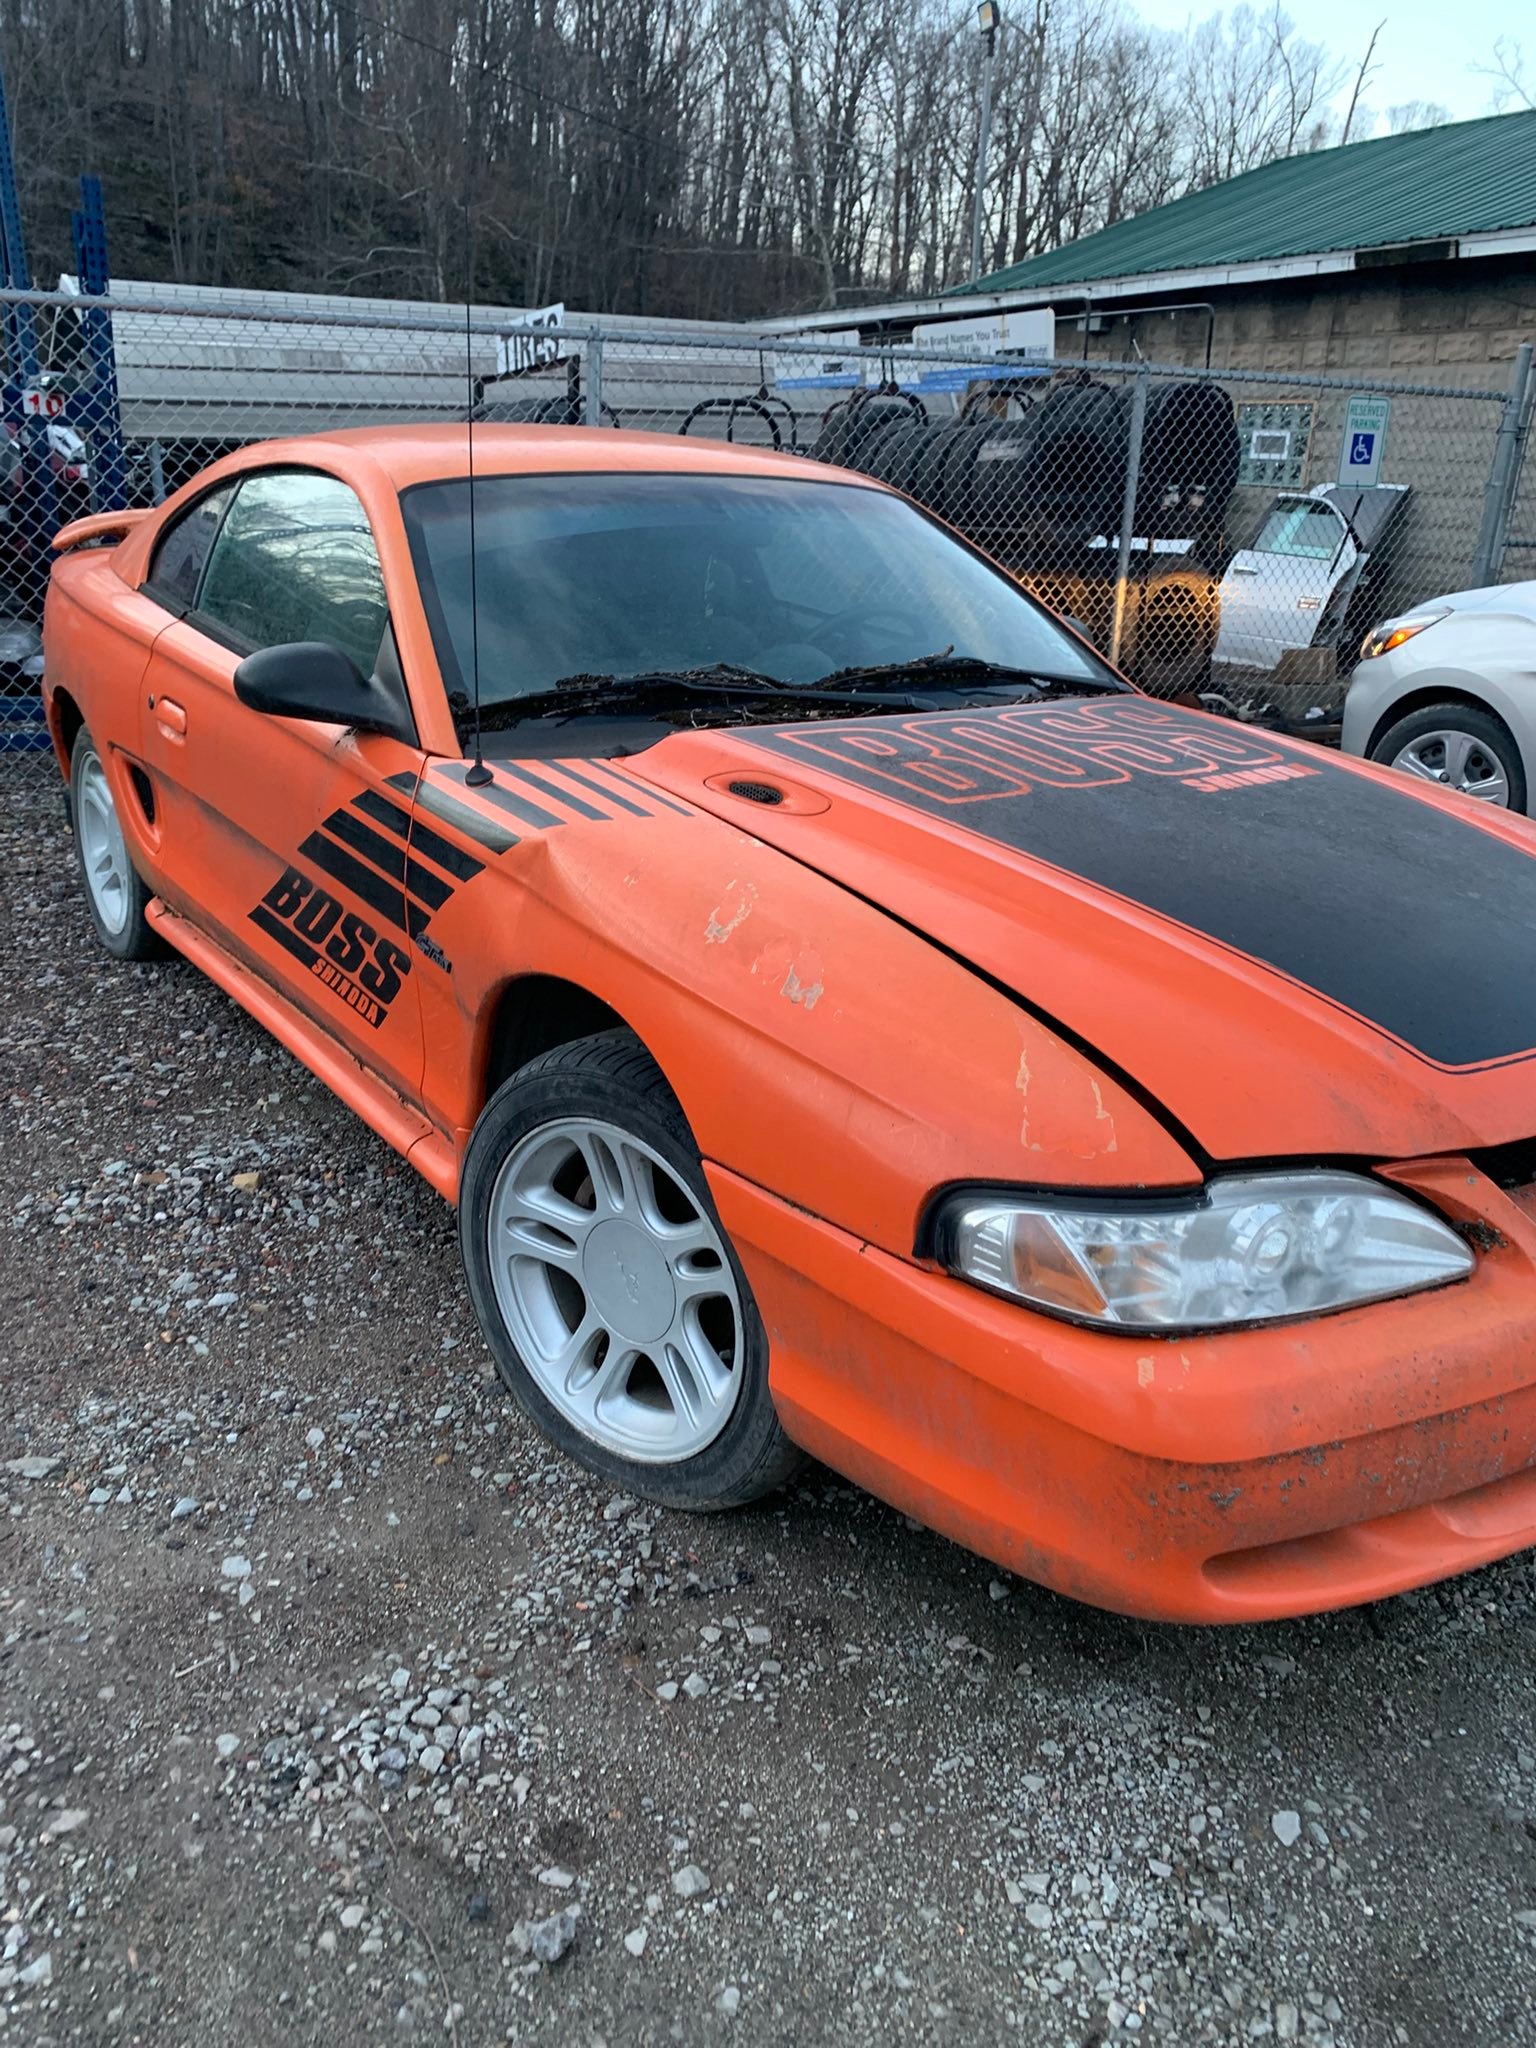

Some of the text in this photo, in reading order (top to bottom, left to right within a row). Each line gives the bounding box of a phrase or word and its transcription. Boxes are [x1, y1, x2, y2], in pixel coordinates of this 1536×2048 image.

[916, 328, 1010, 347] The Brand Names You Trust
[28, 393, 63, 416] 10
[1350, 404, 1386, 417] RESERVED
[1351, 418, 1381, 431] PARKING
[775, 703, 1285, 804] BOSS
[261, 865, 412, 1005] BOSS
[311, 957, 379, 1025] SHINODA
